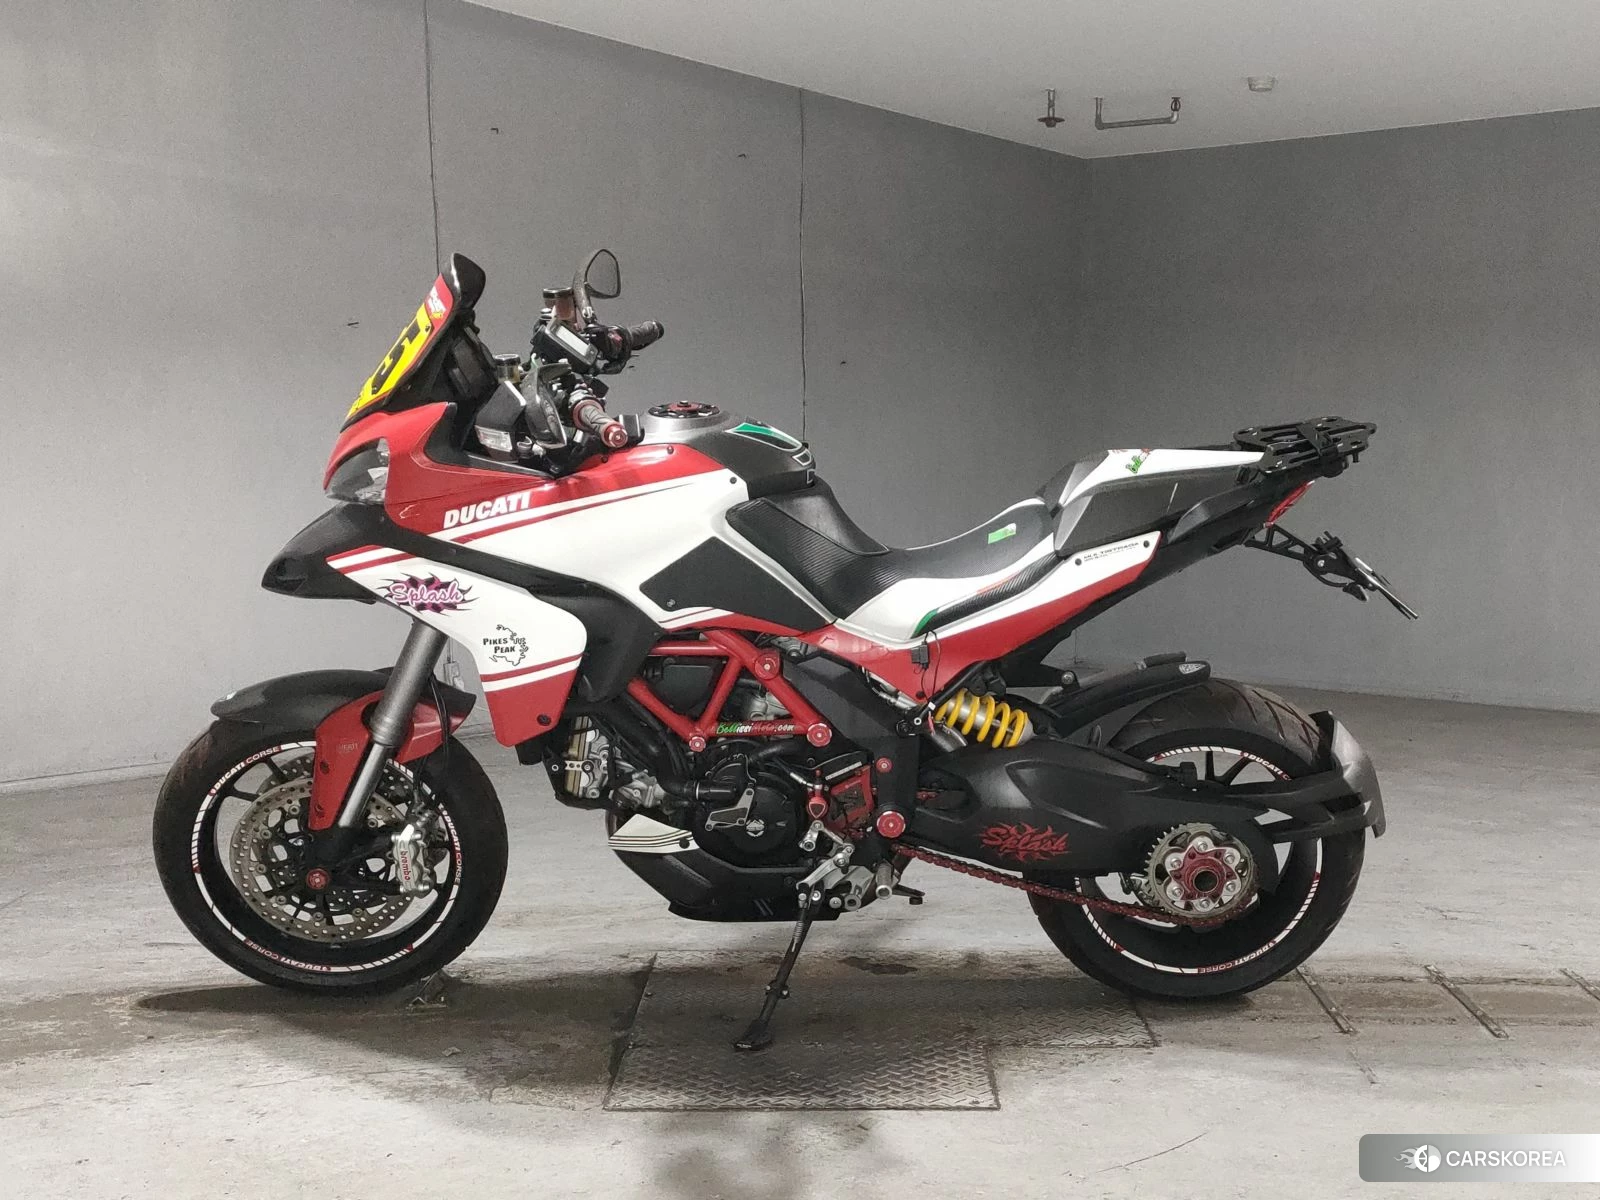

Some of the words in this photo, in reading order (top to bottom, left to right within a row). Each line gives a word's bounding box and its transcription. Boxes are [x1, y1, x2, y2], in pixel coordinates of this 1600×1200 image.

[443, 491, 531, 529] DUCATI
[389, 580, 464, 607] Splash
[482, 637, 508, 646] PIKES
[494, 645, 516, 654] PEAK
[214, 761, 246, 791] DUCATI
[246, 746, 280, 764] CORSE
[1248, 754, 1283, 775] DUCATI
[444, 815, 461, 851] DUCATI
[454, 852, 462, 884] CORSE
[400, 850, 412, 881] brembo
[245, 939, 279, 960] CORSE
[1234, 944, 1269, 966] DUCATI
[280, 957, 320, 971] DUCATI
[1200, 962, 1233, 974] CORSE
